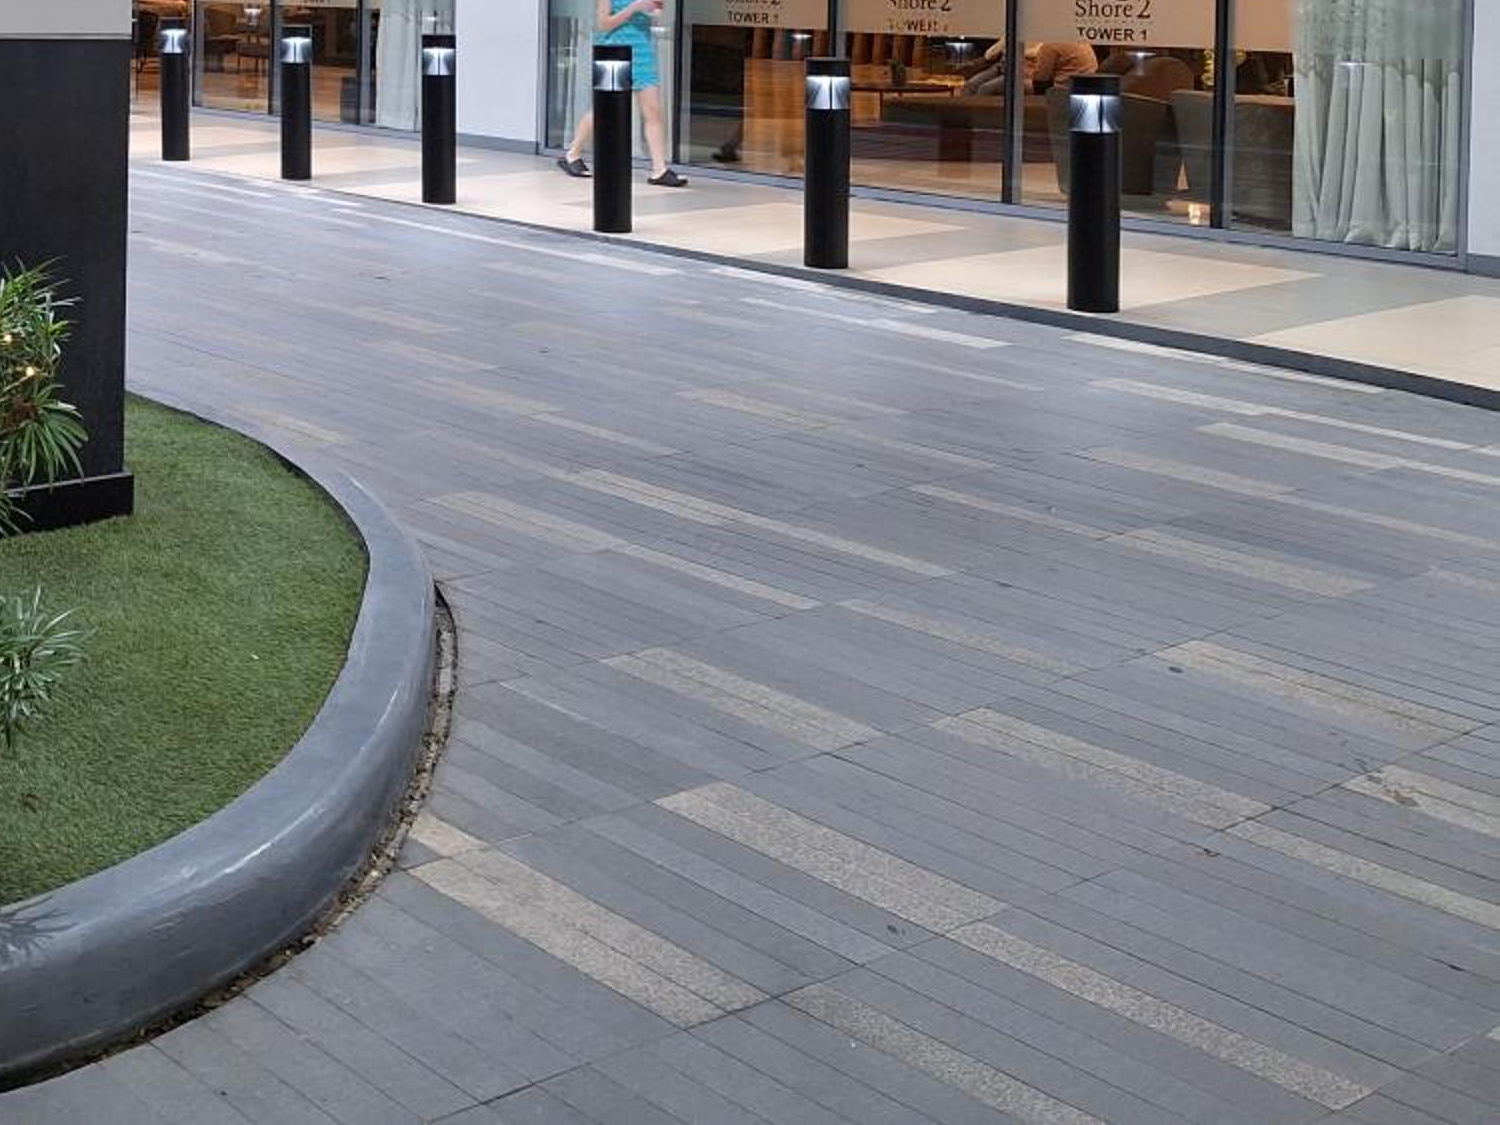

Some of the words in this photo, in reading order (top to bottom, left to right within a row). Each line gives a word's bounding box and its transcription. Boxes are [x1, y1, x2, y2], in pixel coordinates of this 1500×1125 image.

[727, 11, 769, 24] TOWER
[1077, 26, 1134, 41] TOWER
[1140, 29, 1148, 42] 1
